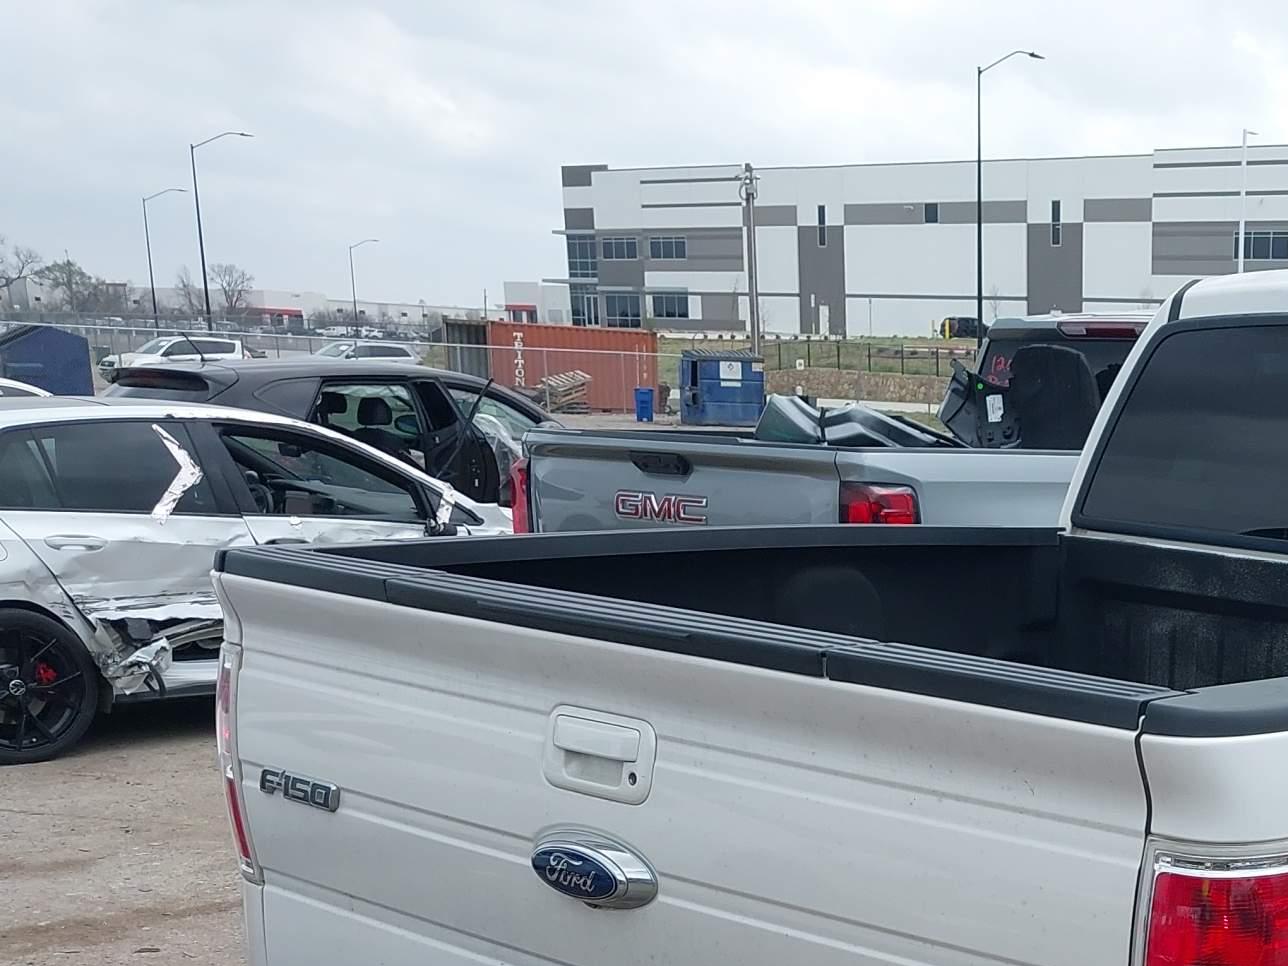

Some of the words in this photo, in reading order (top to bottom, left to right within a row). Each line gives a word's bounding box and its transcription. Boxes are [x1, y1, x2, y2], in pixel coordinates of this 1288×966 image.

[512, 331, 526, 388] TRITON
[614, 491, 708, 525] GMC
[259, 768, 337, 812] F-150
[545, 852, 597, 893] Ford
